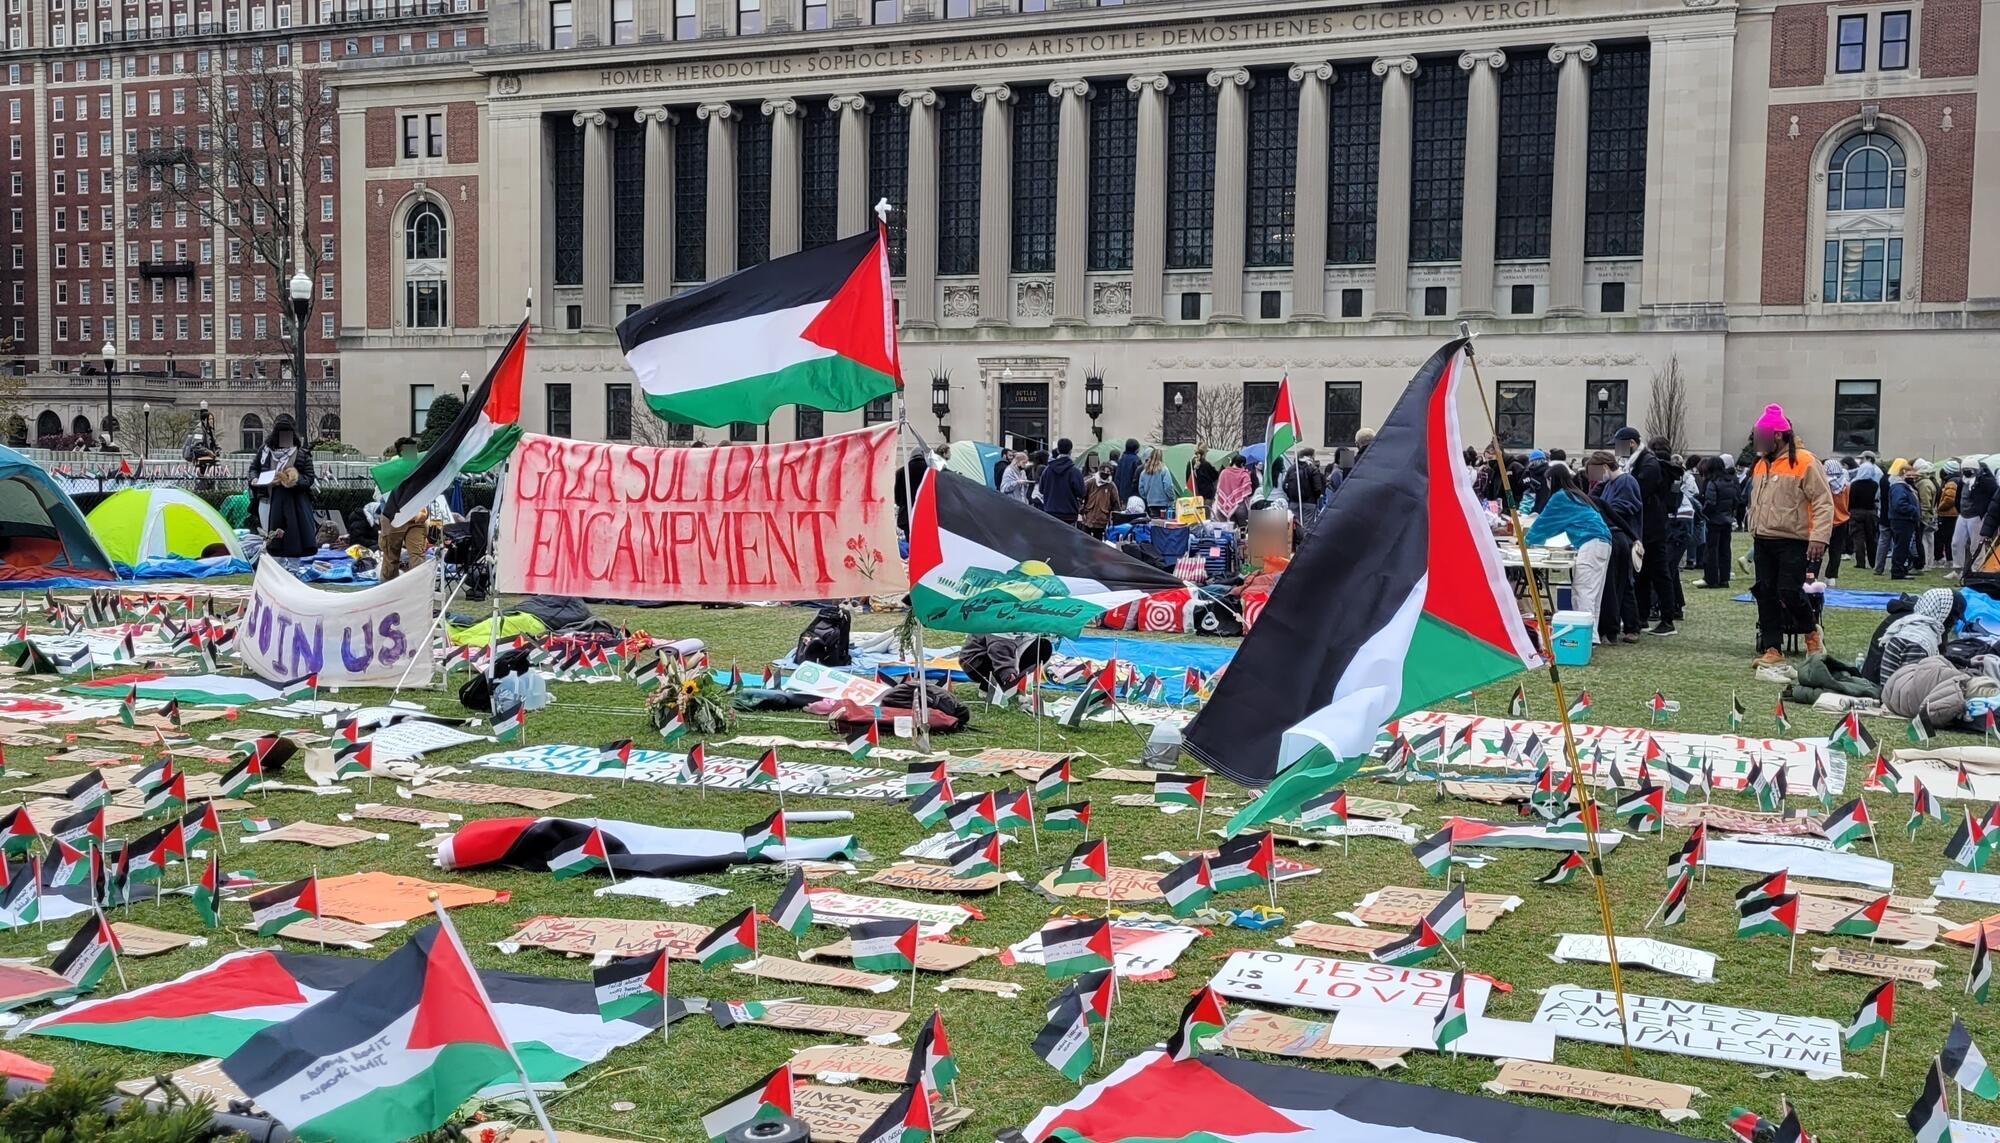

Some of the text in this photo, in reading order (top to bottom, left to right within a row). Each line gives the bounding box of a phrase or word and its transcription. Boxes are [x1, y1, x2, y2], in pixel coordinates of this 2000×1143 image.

[600, 1, 1557, 86] HOMER HERODOTUS SOPHOCLES PLATO ARISTOTLE DEMOSTHENES CICERO VERGIL
[515, 427, 896, 505] GAZA SOLIDARITY
[525, 508, 838, 585] ENCAMPMENT
[249, 591, 324, 679] JOIN
[1076, 885, 1128, 898] FOR
[1305, 926, 1394, 943] DIVEST
[1247, 952, 1283, 963] TO
[1838, 956, 1933, 976] BEAUTIFUL
[1839, 949, 1898, 964] BOLD
[1236, 968, 1263, 979] IS
[1226, 979, 1449, 1009] TO LOVE
[767, 1004, 897, 1028] CEASE
[768, 1016, 877, 1034] FIRE
[1544, 1001, 1832, 1047] AMERICANS
[1546, 1013, 1842, 1067] FOR PALESTINE
